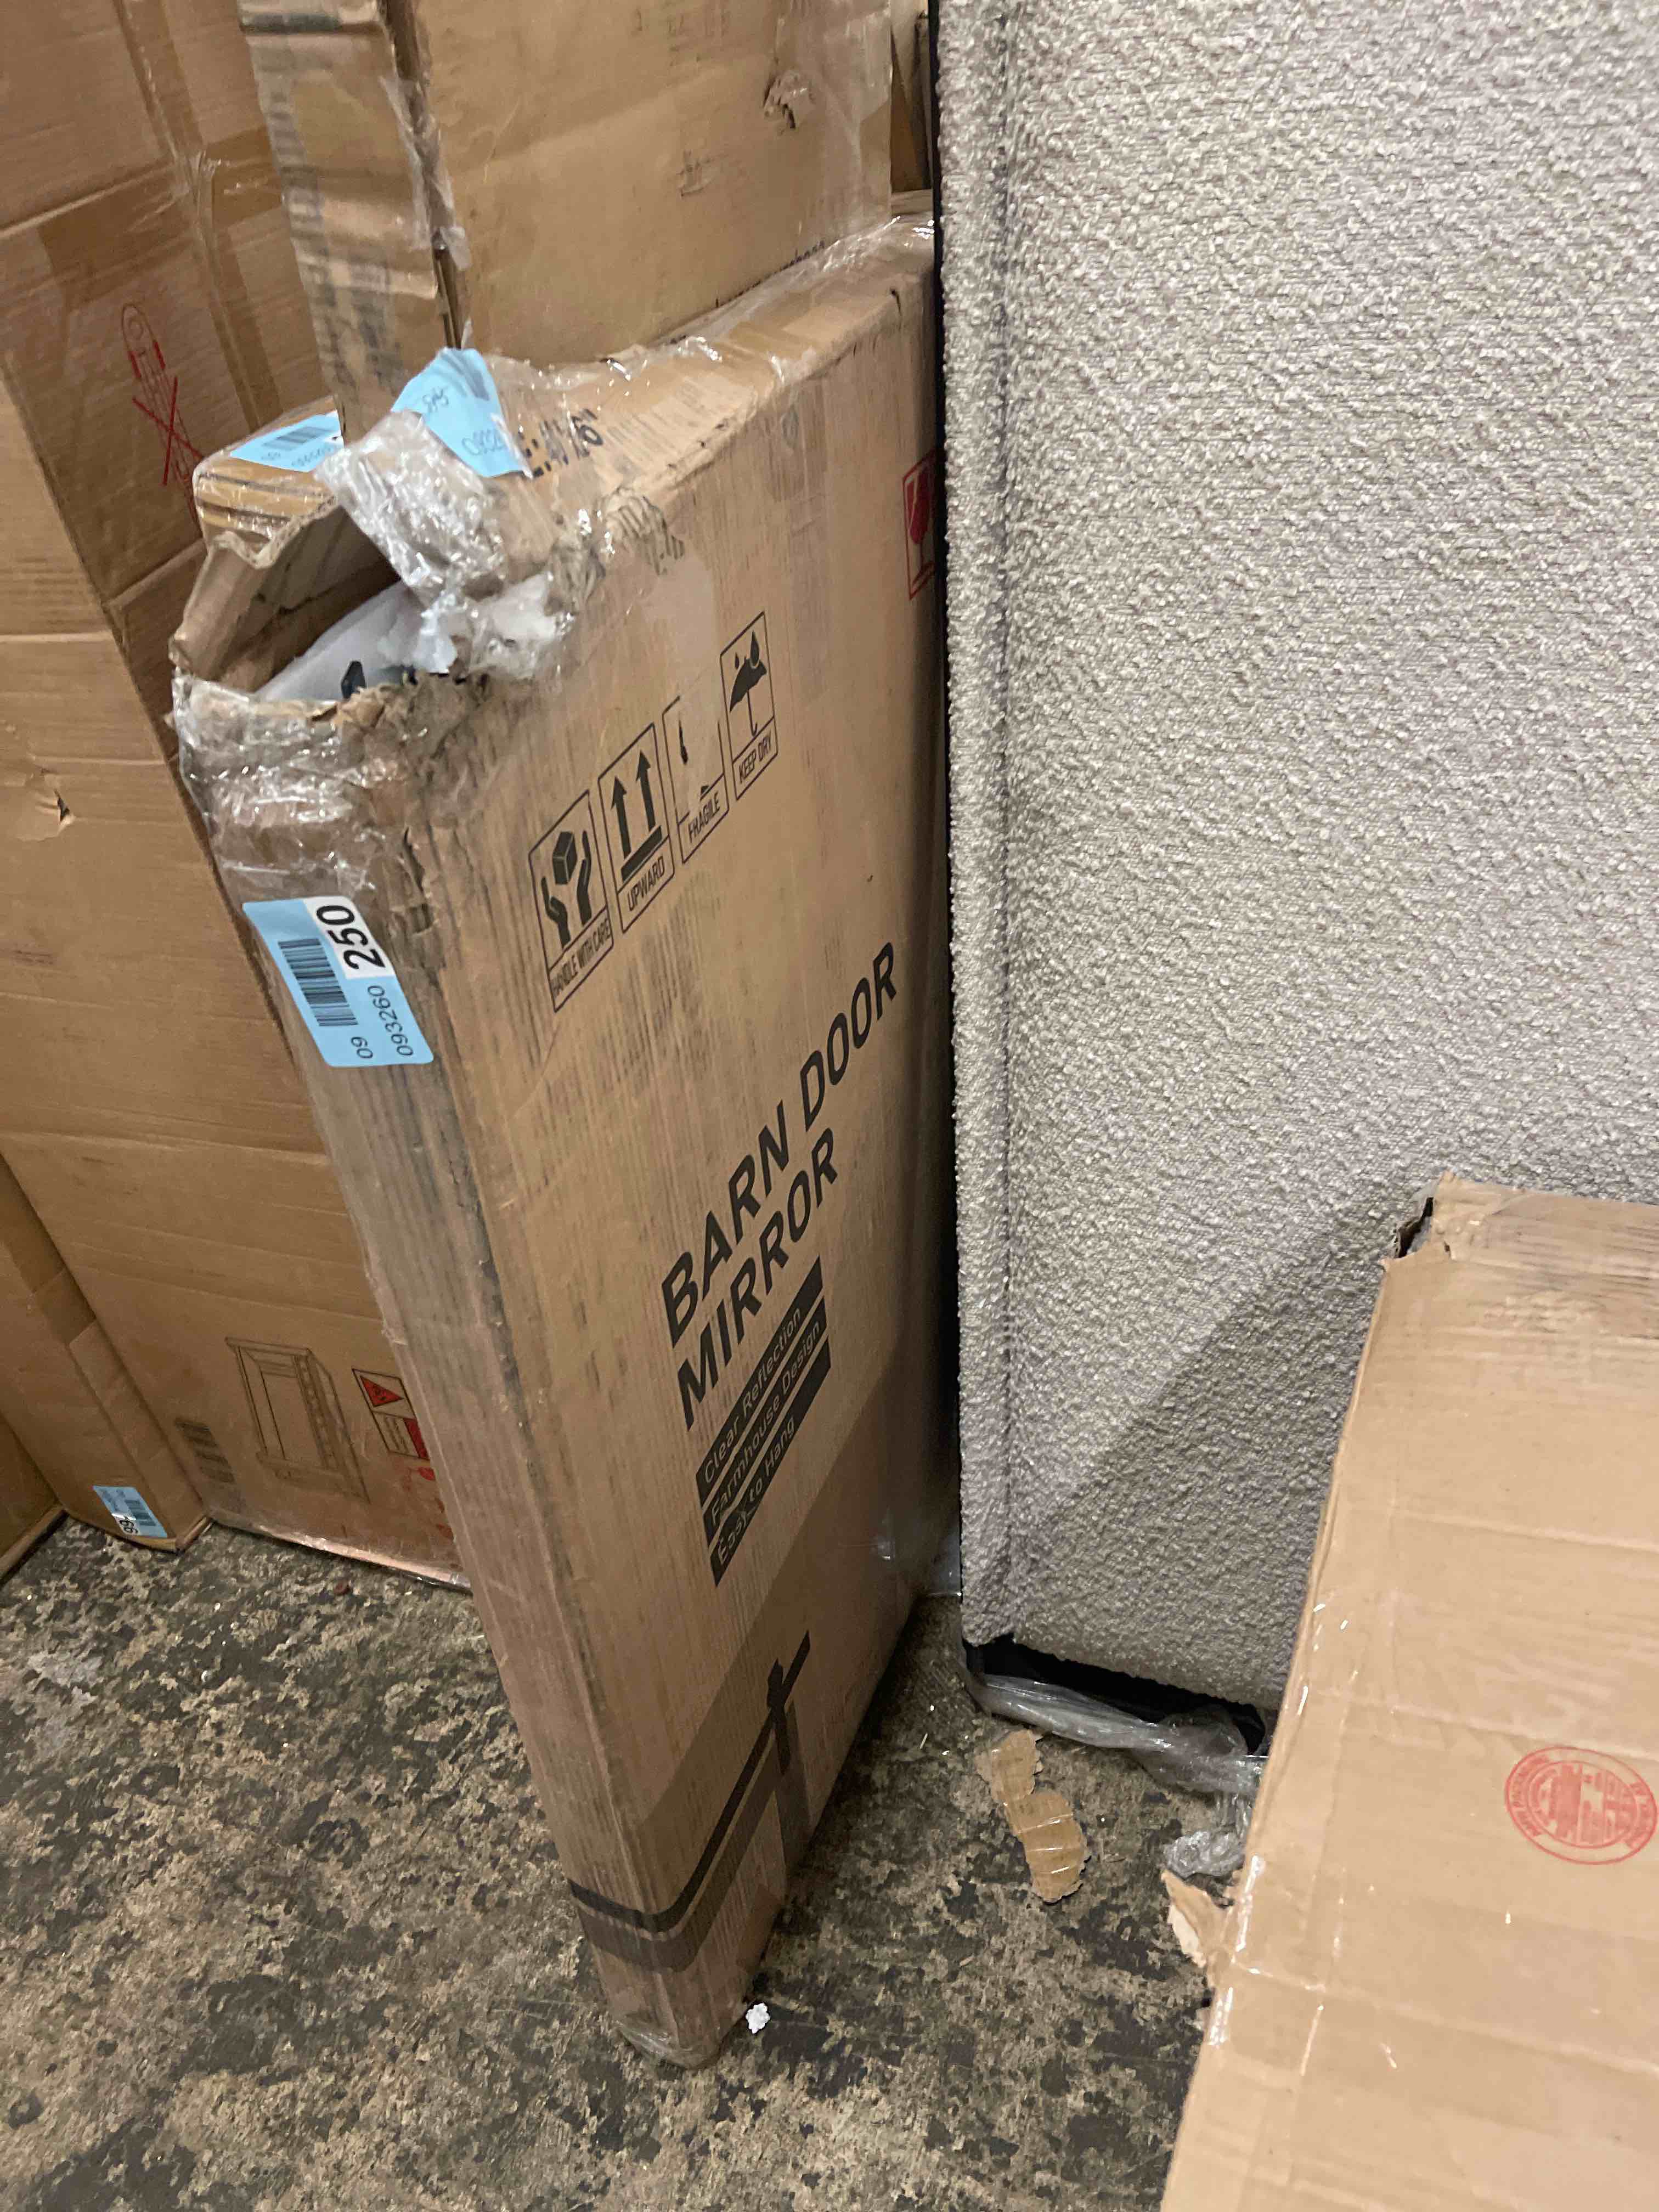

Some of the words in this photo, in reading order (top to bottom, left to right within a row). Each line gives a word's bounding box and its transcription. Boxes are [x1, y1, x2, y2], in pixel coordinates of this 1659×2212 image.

[738, 748, 757, 784] KEEP
[758, 729, 771, 762] DRY
[316, 905, 386, 970] 250
[627, 855, 665, 911] UPWARD
[351, 1036, 374, 1059] 09
[366, 985, 413, 1056] 093260
[662, 1100, 789, 1348] BARN
[800, 941, 897, 1132] DOOR
[678, 1127, 838, 1432] MIRROR
[704, 1415, 739, 1483] Clear
[743, 1308, 801, 1418] Reflection
[711, 1395, 780, 1527] Farmhouse
[782, 1321, 820, 1395] Design
[718, 1509, 747, 1564] Easy
[750, 1478, 763, 1502] to
[765, 1417, 795, 1477] Hang
